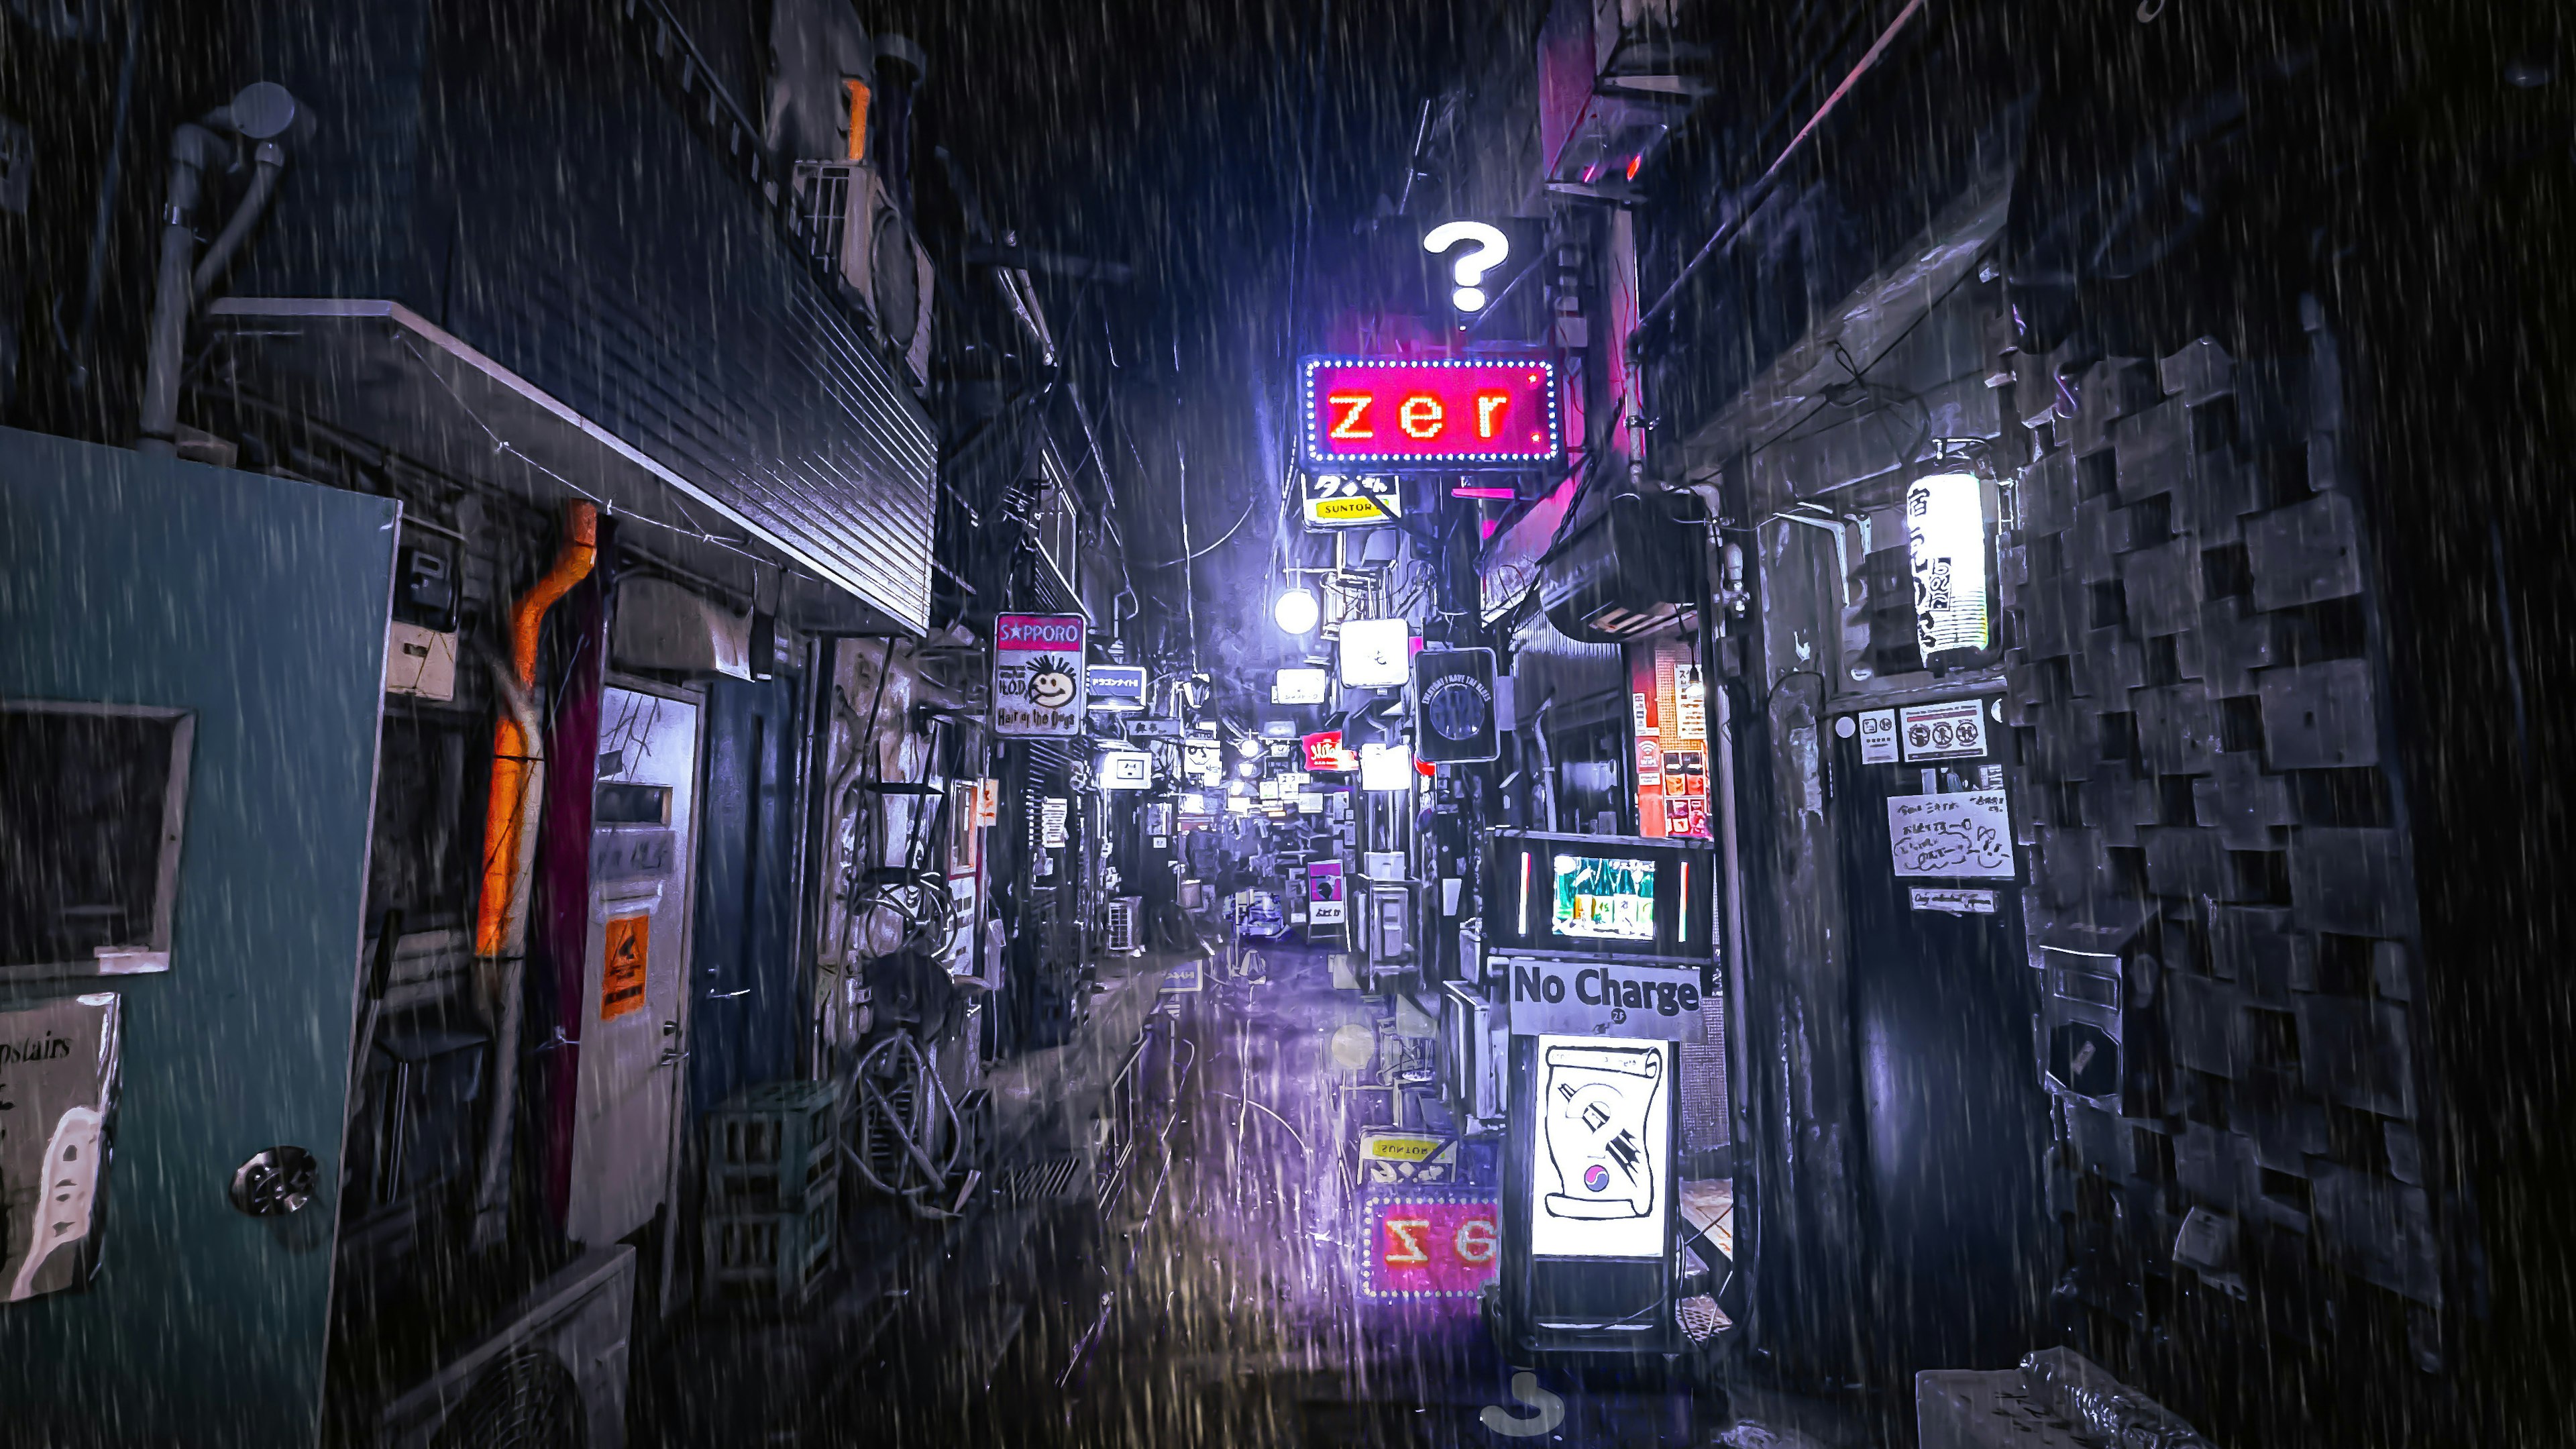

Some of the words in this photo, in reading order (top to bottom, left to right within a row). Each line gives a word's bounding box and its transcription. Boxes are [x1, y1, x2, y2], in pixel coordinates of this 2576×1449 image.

[1326, 504, 1381, 513] SUNTOR
[998, 708, 1019, 727] Hair
[1515, 965, 1566, 1004] No
[1575, 967, 1700, 1017] Charge
